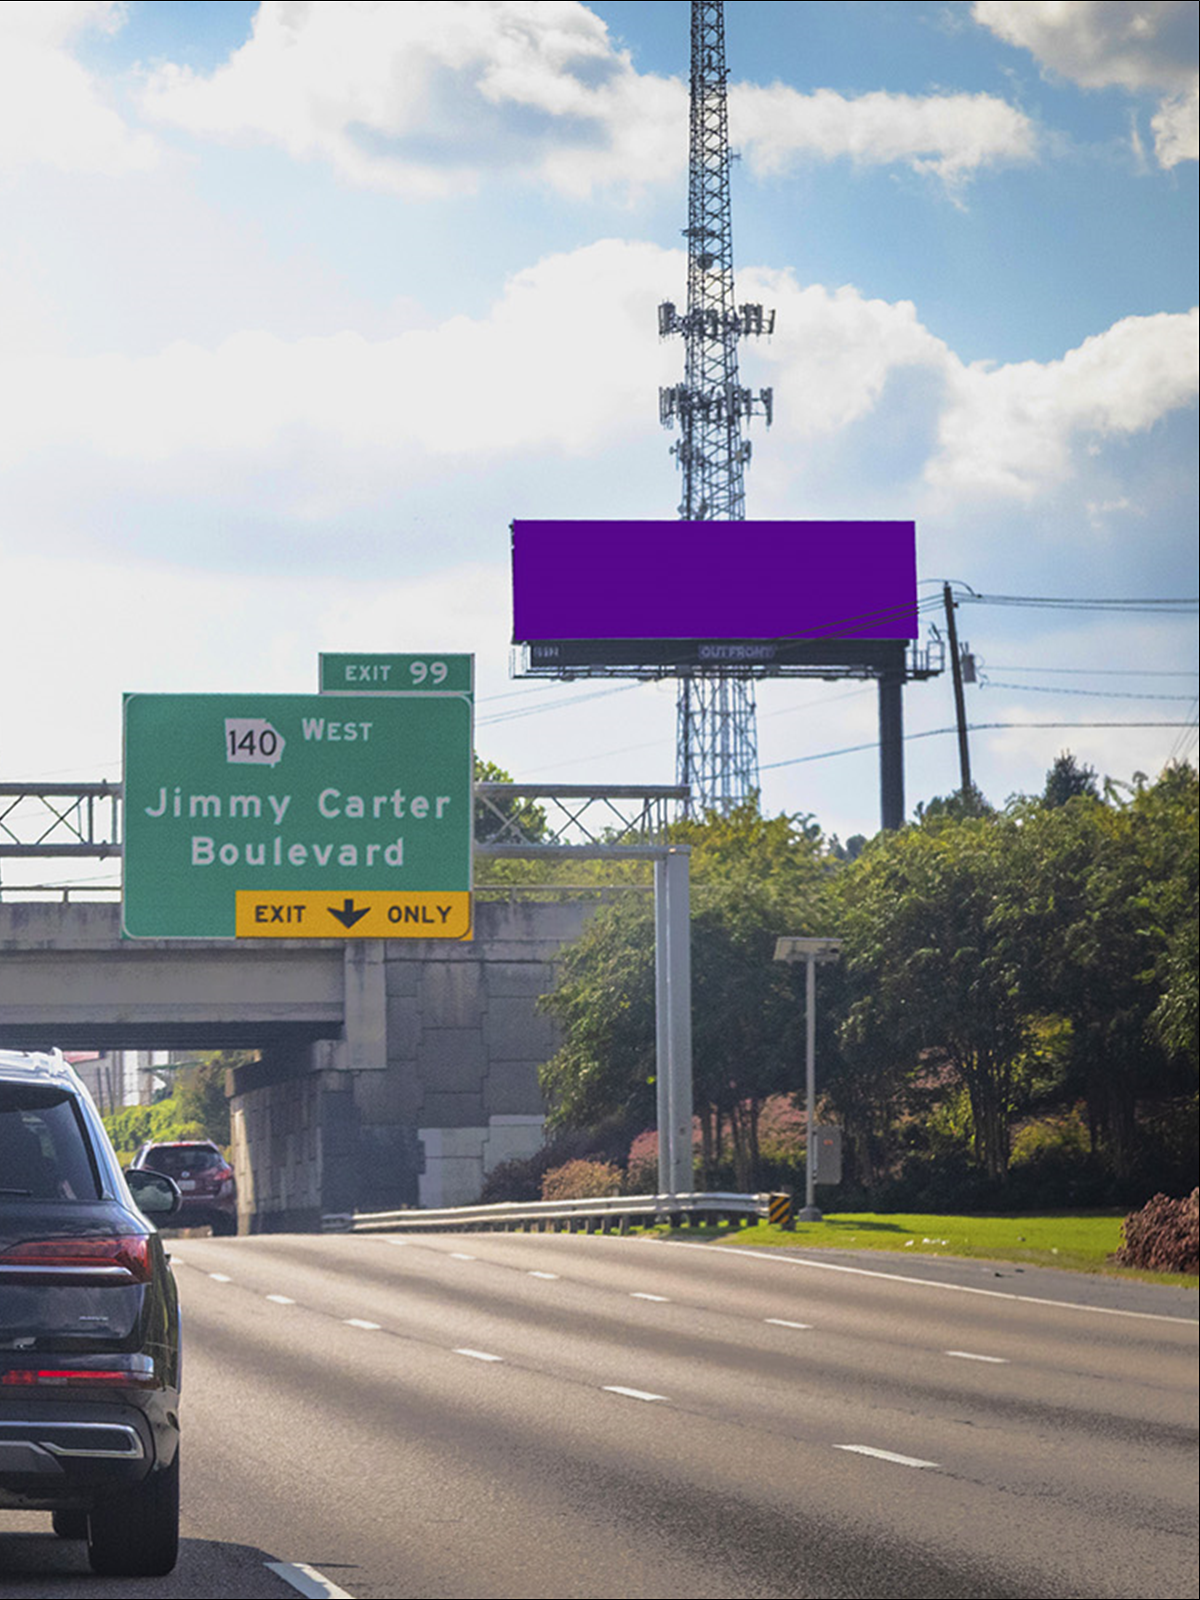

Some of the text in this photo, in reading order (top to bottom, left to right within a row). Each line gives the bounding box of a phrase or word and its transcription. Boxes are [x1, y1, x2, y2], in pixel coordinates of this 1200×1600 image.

[345, 662, 448, 684] EXIT 99
[301, 718, 373, 741] WEST
[228, 730, 277, 756] 140
[145, 787, 451, 825] Jimmy Carter
[191, 836, 404, 866] Boulevard
[255, 906, 452, 923] EXIT ONLY
